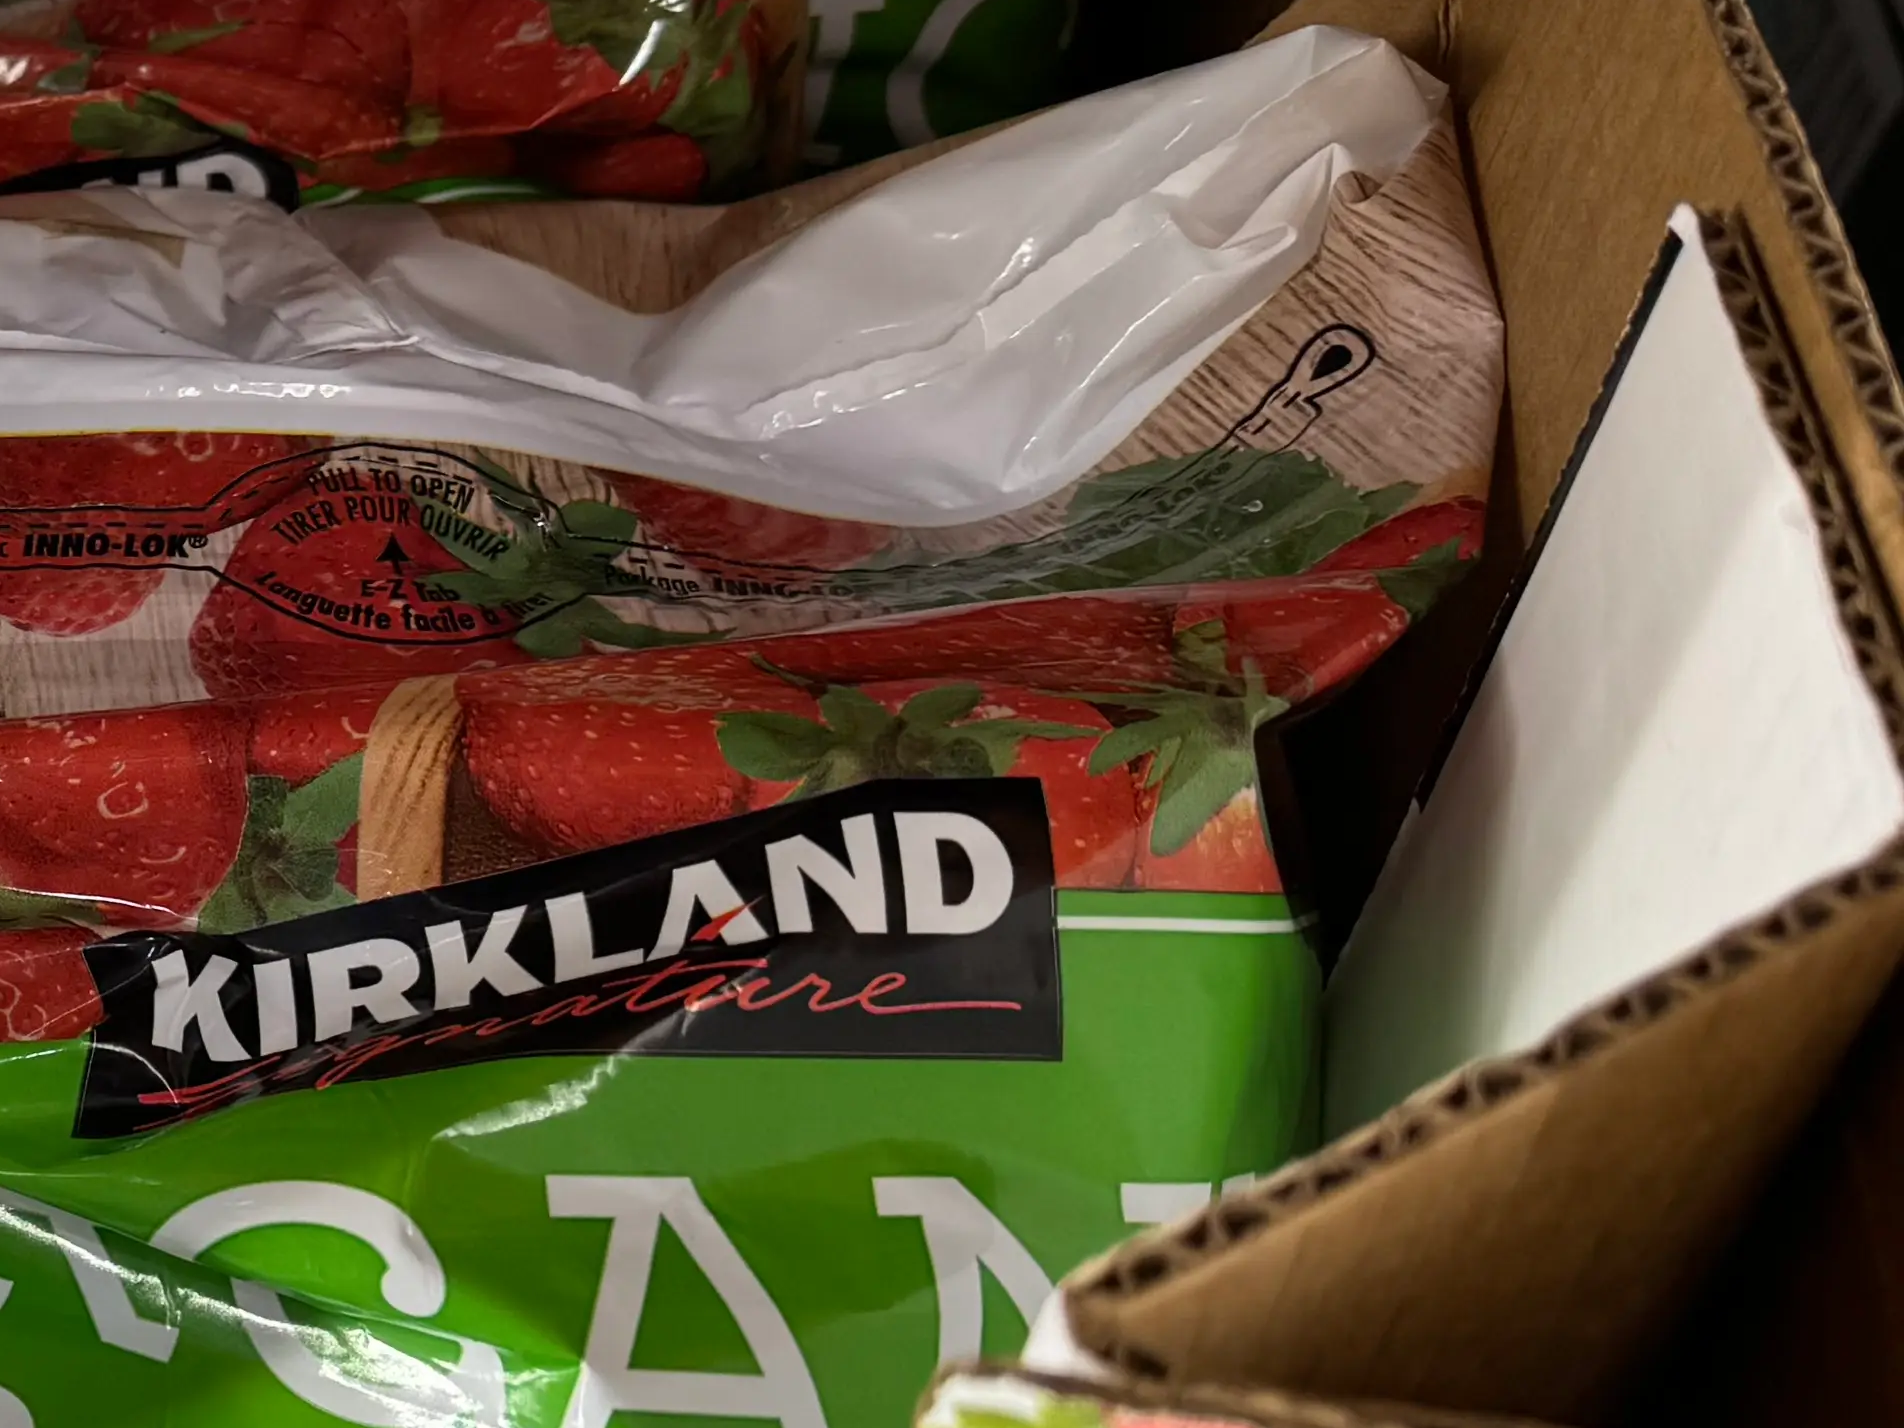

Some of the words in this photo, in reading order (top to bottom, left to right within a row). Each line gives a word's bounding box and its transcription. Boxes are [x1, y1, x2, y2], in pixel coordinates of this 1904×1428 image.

[308, 468, 367, 496] PULL
[371, 467, 402, 495] TO
[410, 473, 475, 515] OPEN
[270, 495, 342, 547] TIRER
[344, 494, 412, 527] POUR
[418, 503, 511, 563] OUVRIR
[254, 571, 393, 631] Languette
[401, 604, 477, 634] facile
[149, 811, 1017, 1062] KIRKLAND
